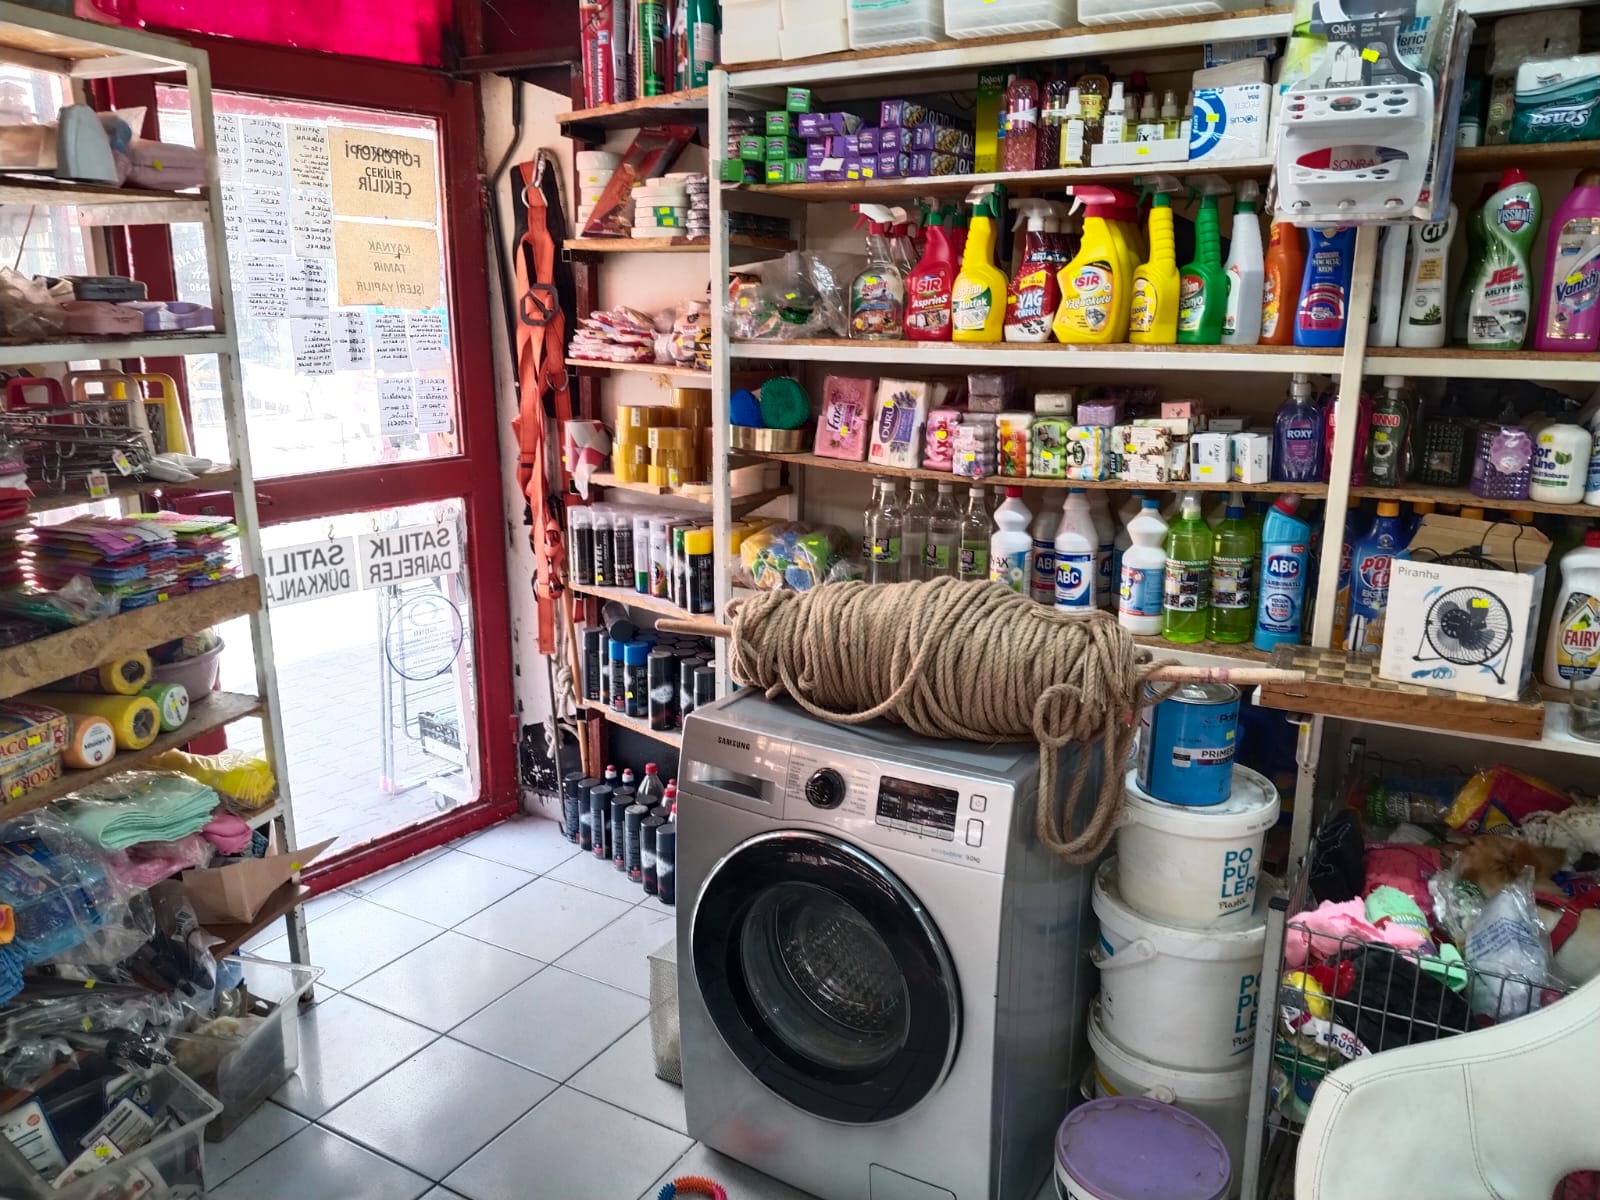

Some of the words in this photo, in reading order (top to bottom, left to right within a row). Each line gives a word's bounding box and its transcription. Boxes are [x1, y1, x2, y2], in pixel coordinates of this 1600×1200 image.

[1331, 24, 1356, 34] Qlux
[1075, 276, 1101, 288] SIR
[1485, 265, 1524, 288] JEL
[917, 278, 942, 293] SIR
[1556, 269, 1600, 302] Vanish
[881, 408, 896, 438] DURU
[936, 420, 951, 457] RXY
[1286, 429, 1313, 439] ROXY
[1269, 558, 1298, 573] ABC
[1398, 566, 1440, 580] Piranha
[1057, 572, 1080, 585] ABC
[1564, 629, 1600, 648] FAIRY
[717, 736, 751, 750] SAMSUNG
[1220, 876, 1256, 899] LER
